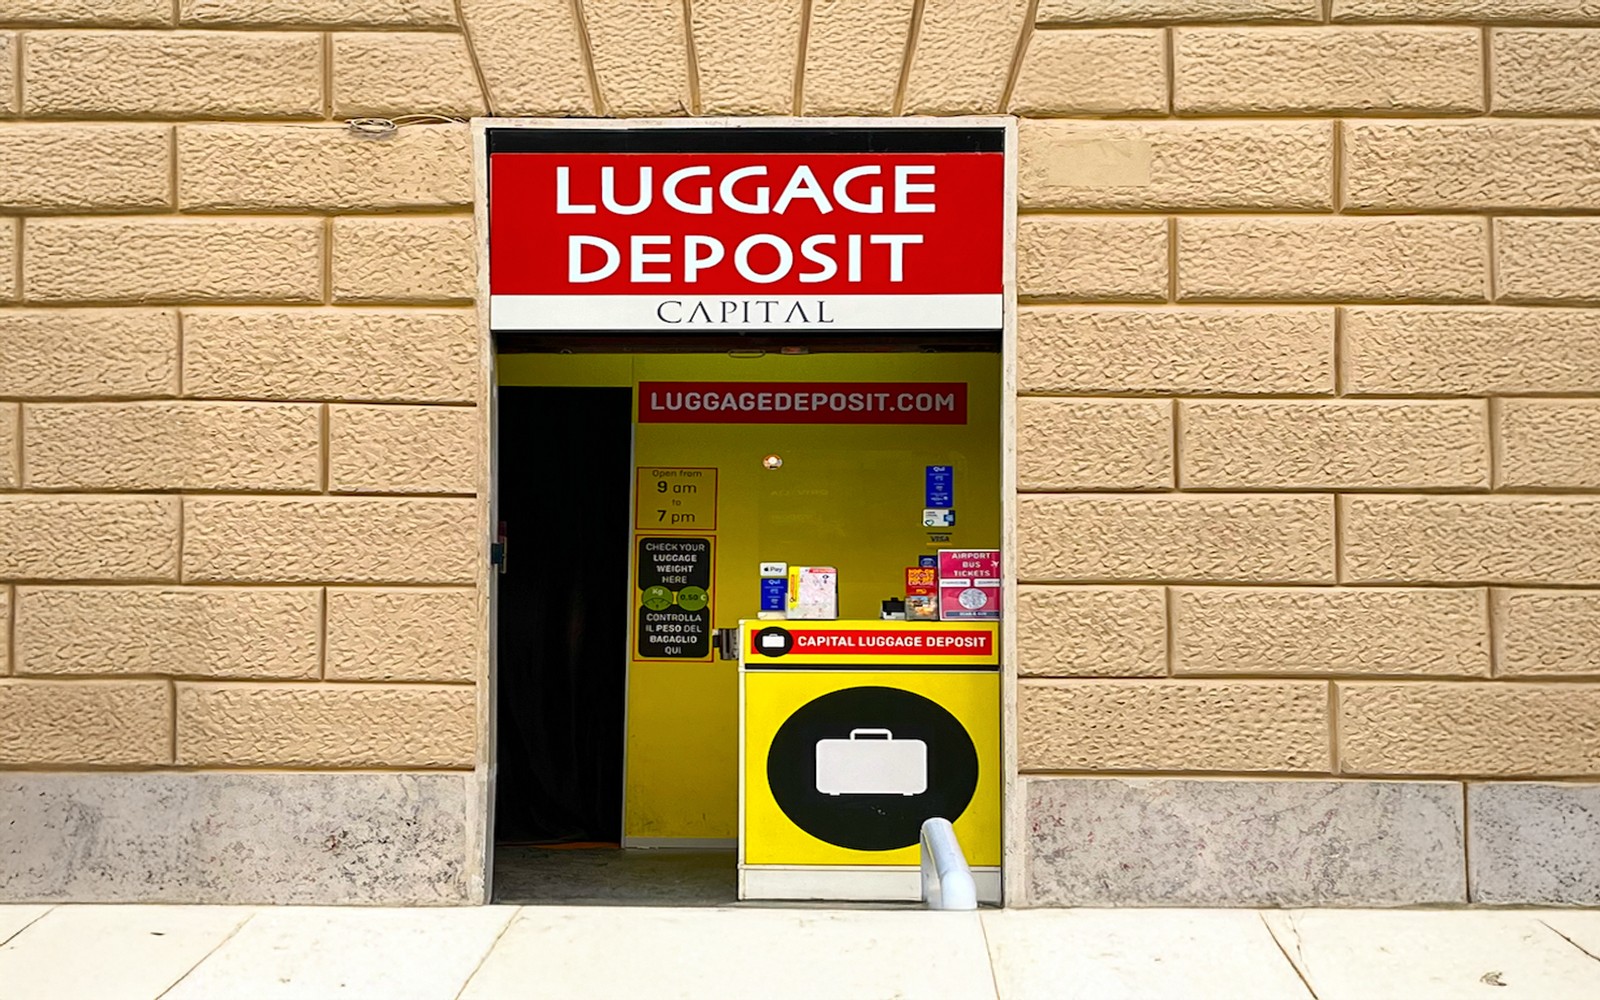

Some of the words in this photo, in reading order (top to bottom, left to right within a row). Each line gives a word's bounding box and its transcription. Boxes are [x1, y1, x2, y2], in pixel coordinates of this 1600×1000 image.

[556, 165, 936, 215] LUGGAGE
[567, 233, 925, 284] DEPOSIT
[656, 300, 834, 324] CAPITAL
[650, 392, 956, 413] LUGGAGEDEPOSIT.COM
[652, 469, 677, 478] Open
[679, 469, 702, 477] from
[657, 480, 667, 493] 9
[673, 484, 697, 493] am
[657, 509, 667, 522] 7
[671, 513, 695, 524] pm
[645, 542, 678, 551] CHECK
[679, 543, 706, 552] YOUR
[653, 554, 698, 562] LUGGAGE
[656, 564, 694, 573] WEIGHT
[661, 575, 688, 584] HERE
[646, 613, 702, 622] CONTROLLA
[645, 624, 654, 632] IL
[655, 624, 682, 633] PESO
[683, 624, 702, 633] DEL
[649, 635, 698, 644] BAGAGLIO
[797, 635, 856, 647] CAPITAL
[858, 636, 923, 648] LUGGAGE
[926, 636, 987, 648] DEPOSIT
[664, 646, 682, 655] QUI
